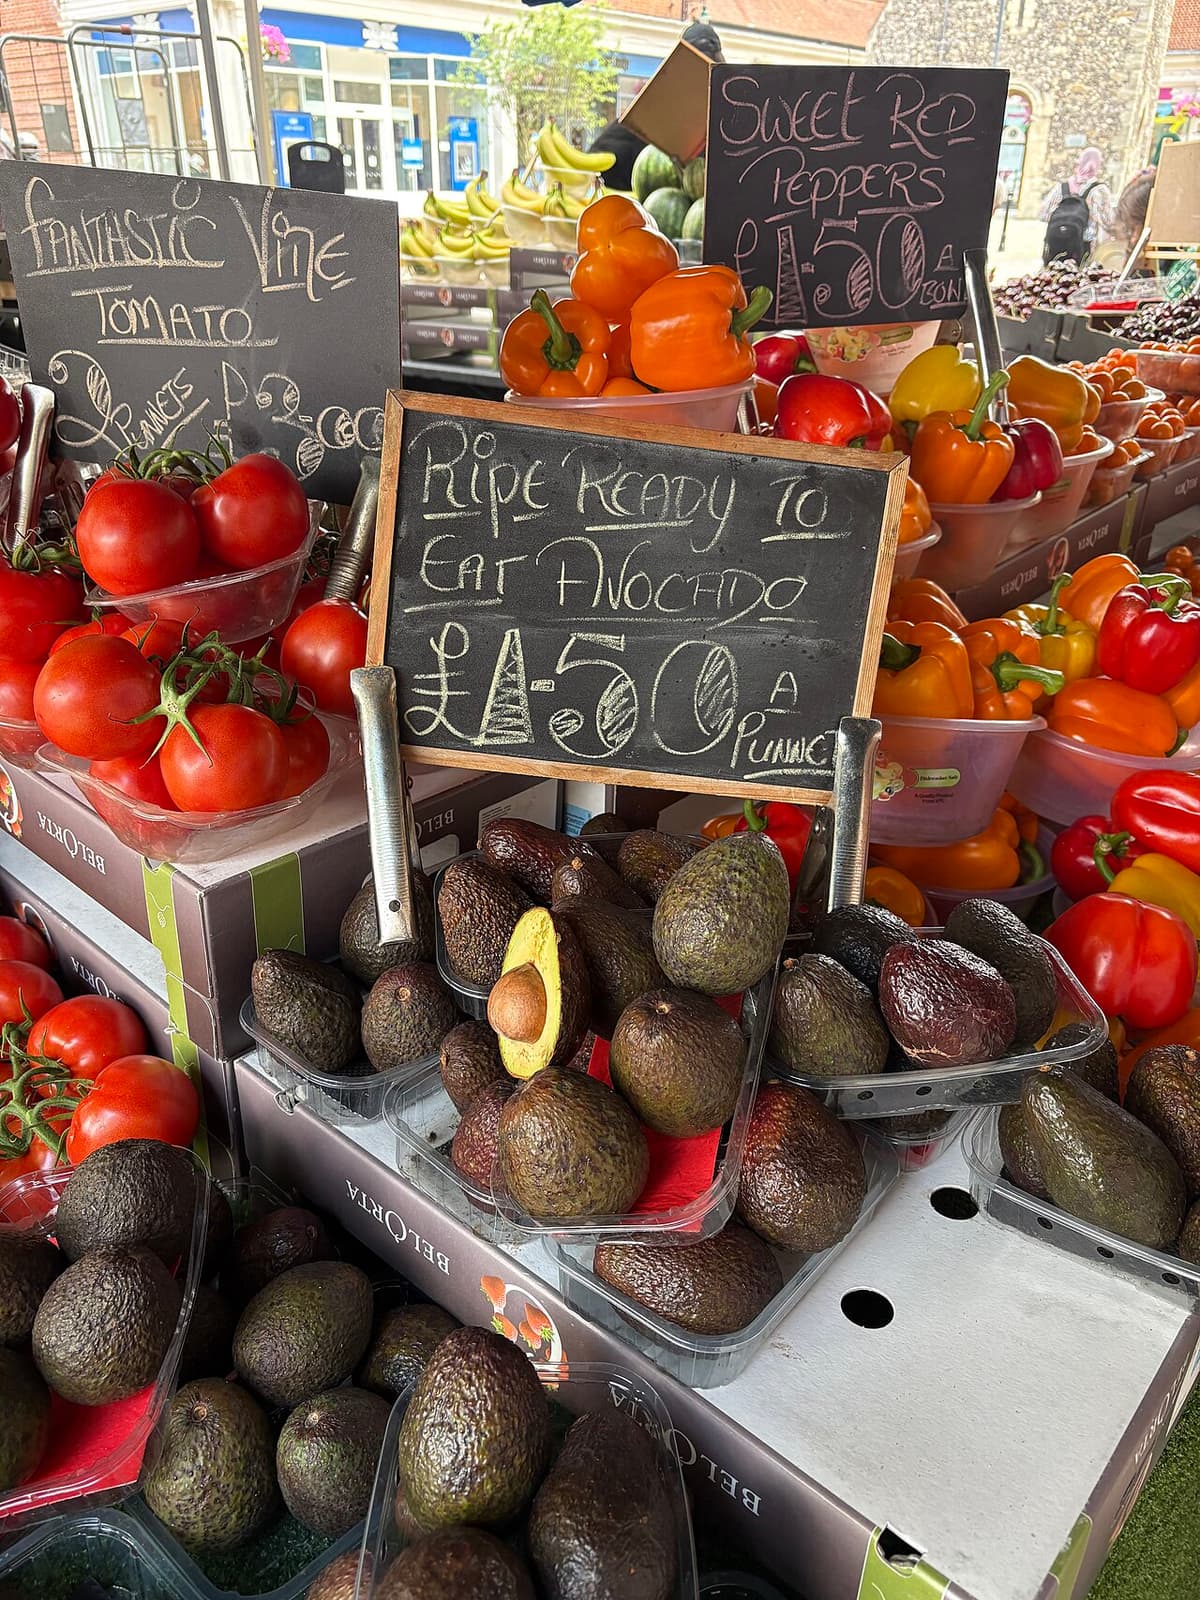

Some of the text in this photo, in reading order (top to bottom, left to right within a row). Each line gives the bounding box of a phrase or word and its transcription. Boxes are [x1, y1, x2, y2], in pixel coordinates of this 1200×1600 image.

[875, 73, 976, 159] RED
[739, 146, 946, 219] PEPPERS
[938, 244, 955, 271] A
[420, 534, 808, 631] EAT AVOCADO
[770, 671, 798, 706] A
[37, 811, 106, 875] BELORTA
[345, 1179, 450, 1276] BELORTA
